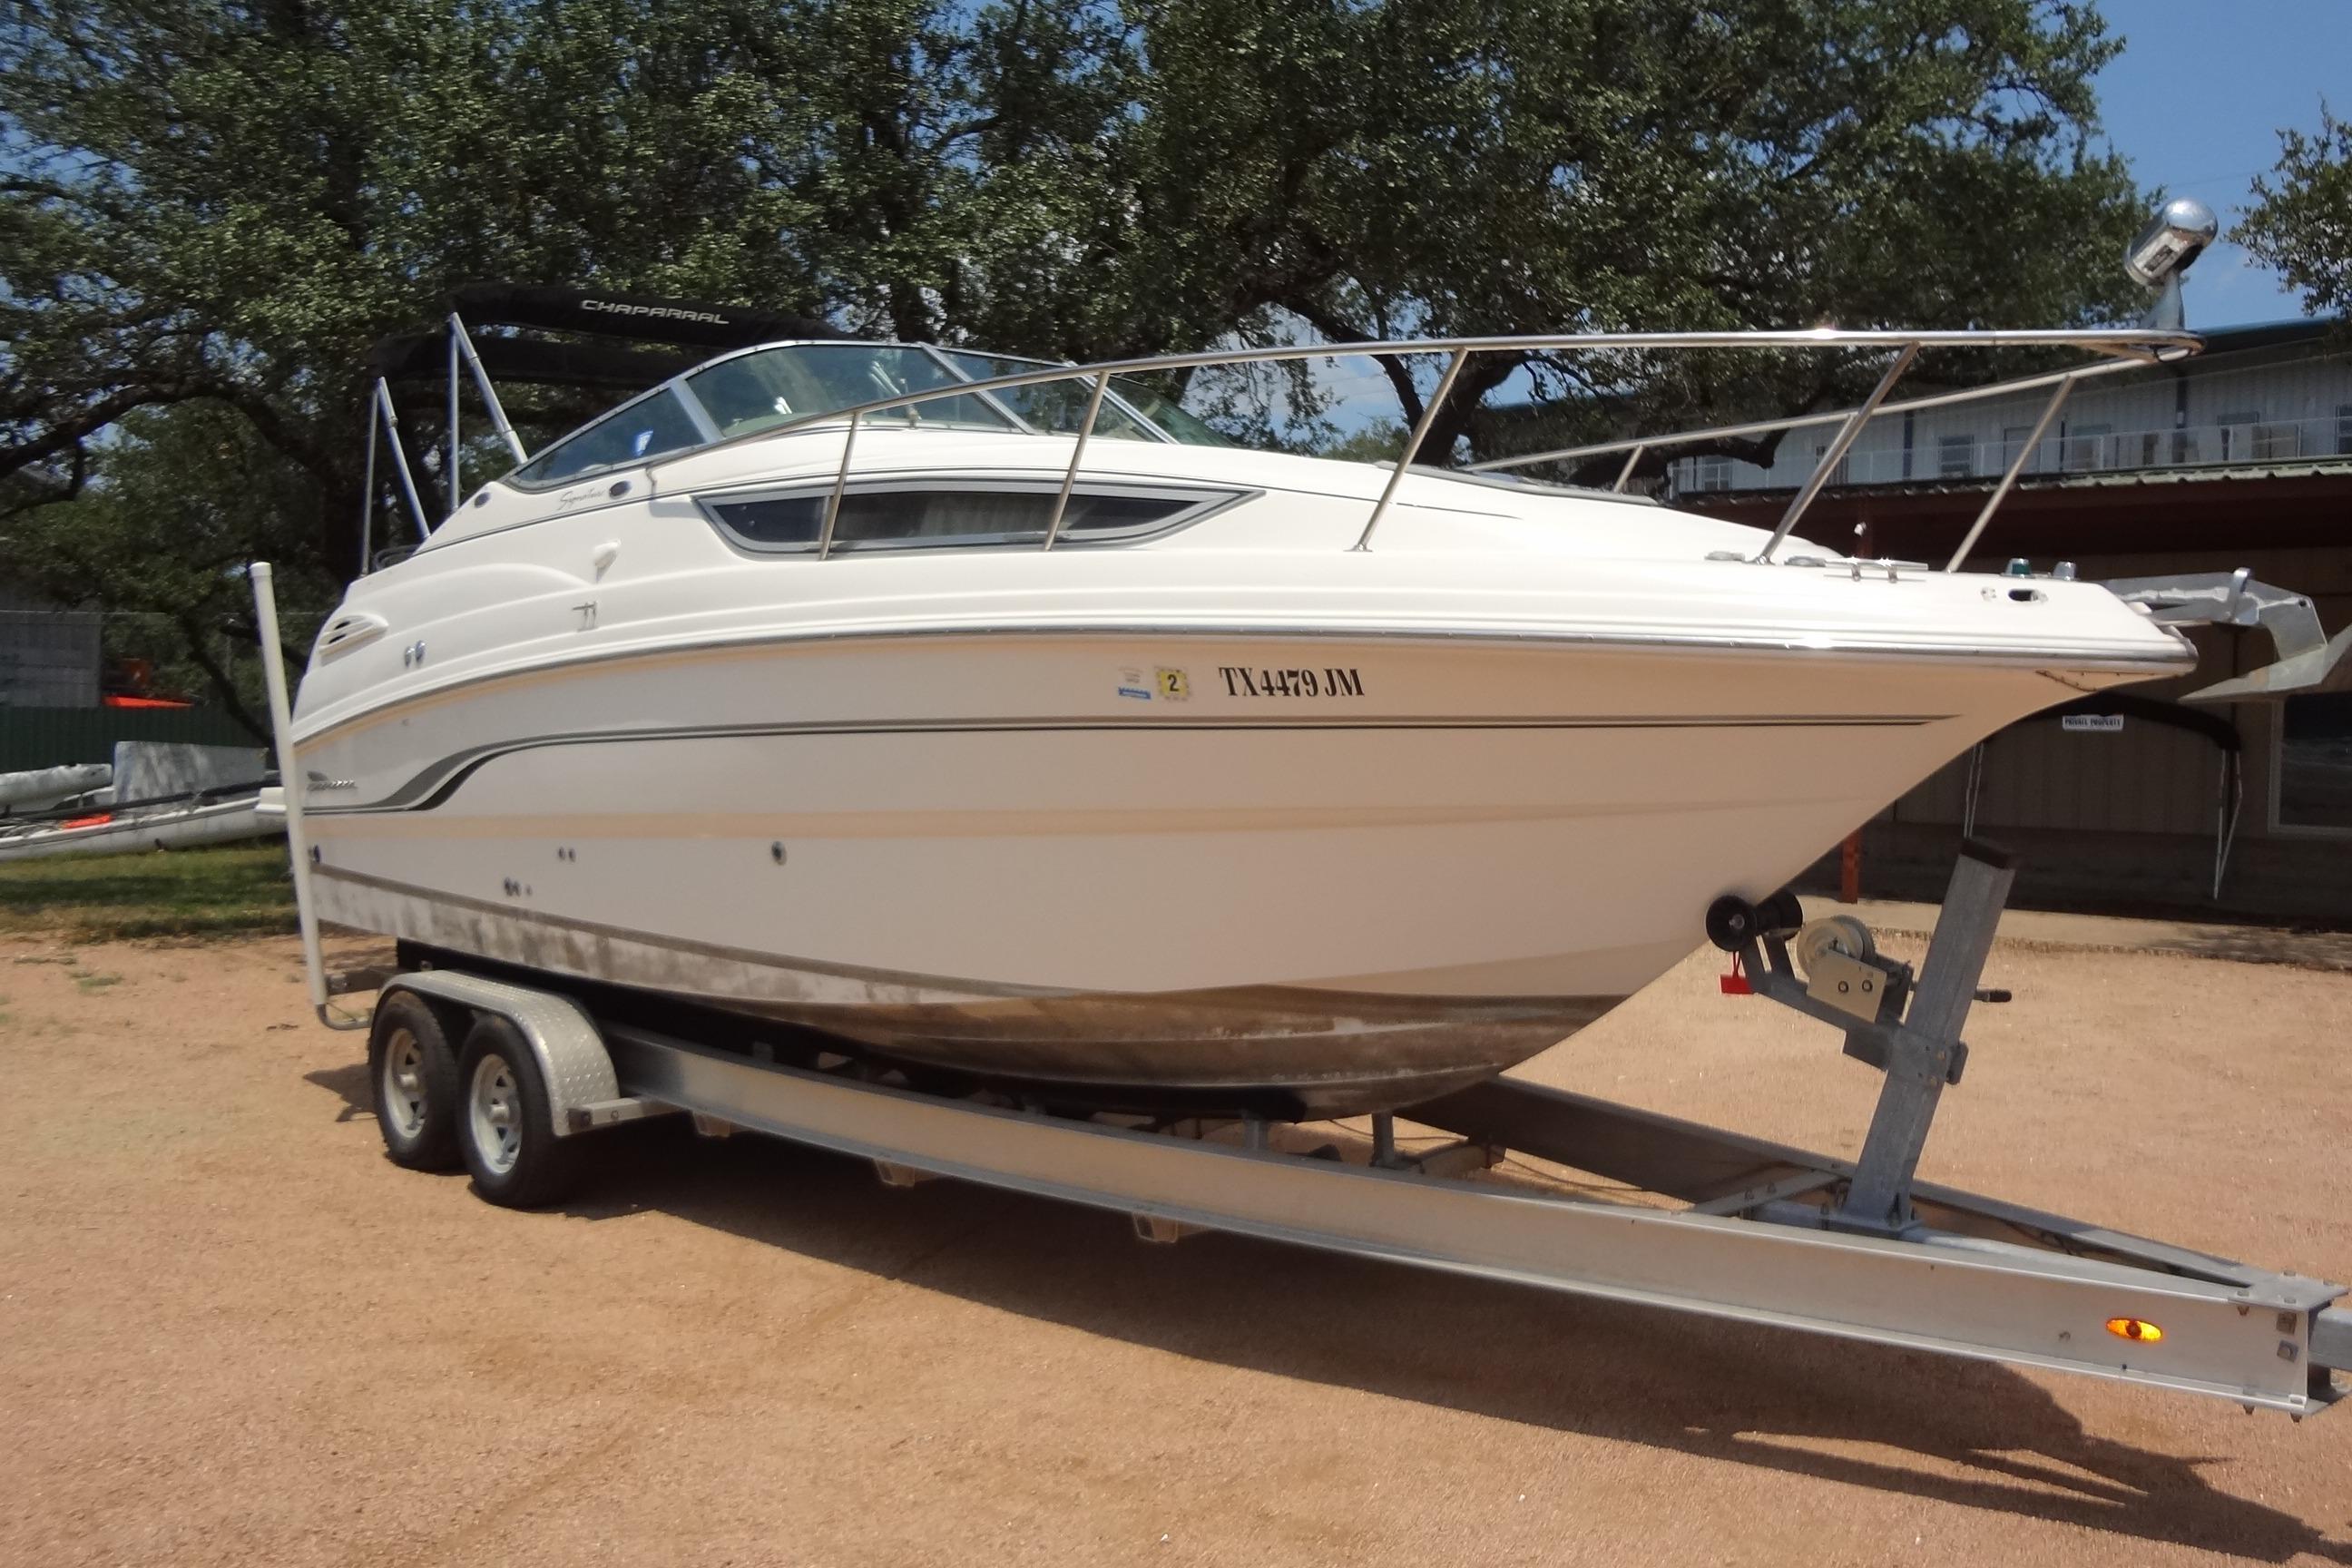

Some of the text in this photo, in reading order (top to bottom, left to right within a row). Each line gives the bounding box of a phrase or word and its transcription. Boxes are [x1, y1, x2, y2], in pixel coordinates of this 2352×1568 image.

[580, 299, 730, 325] CHAPARRAL
[1167, 673, 1180, 691] 2
[1323, 668, 1365, 697] JM
